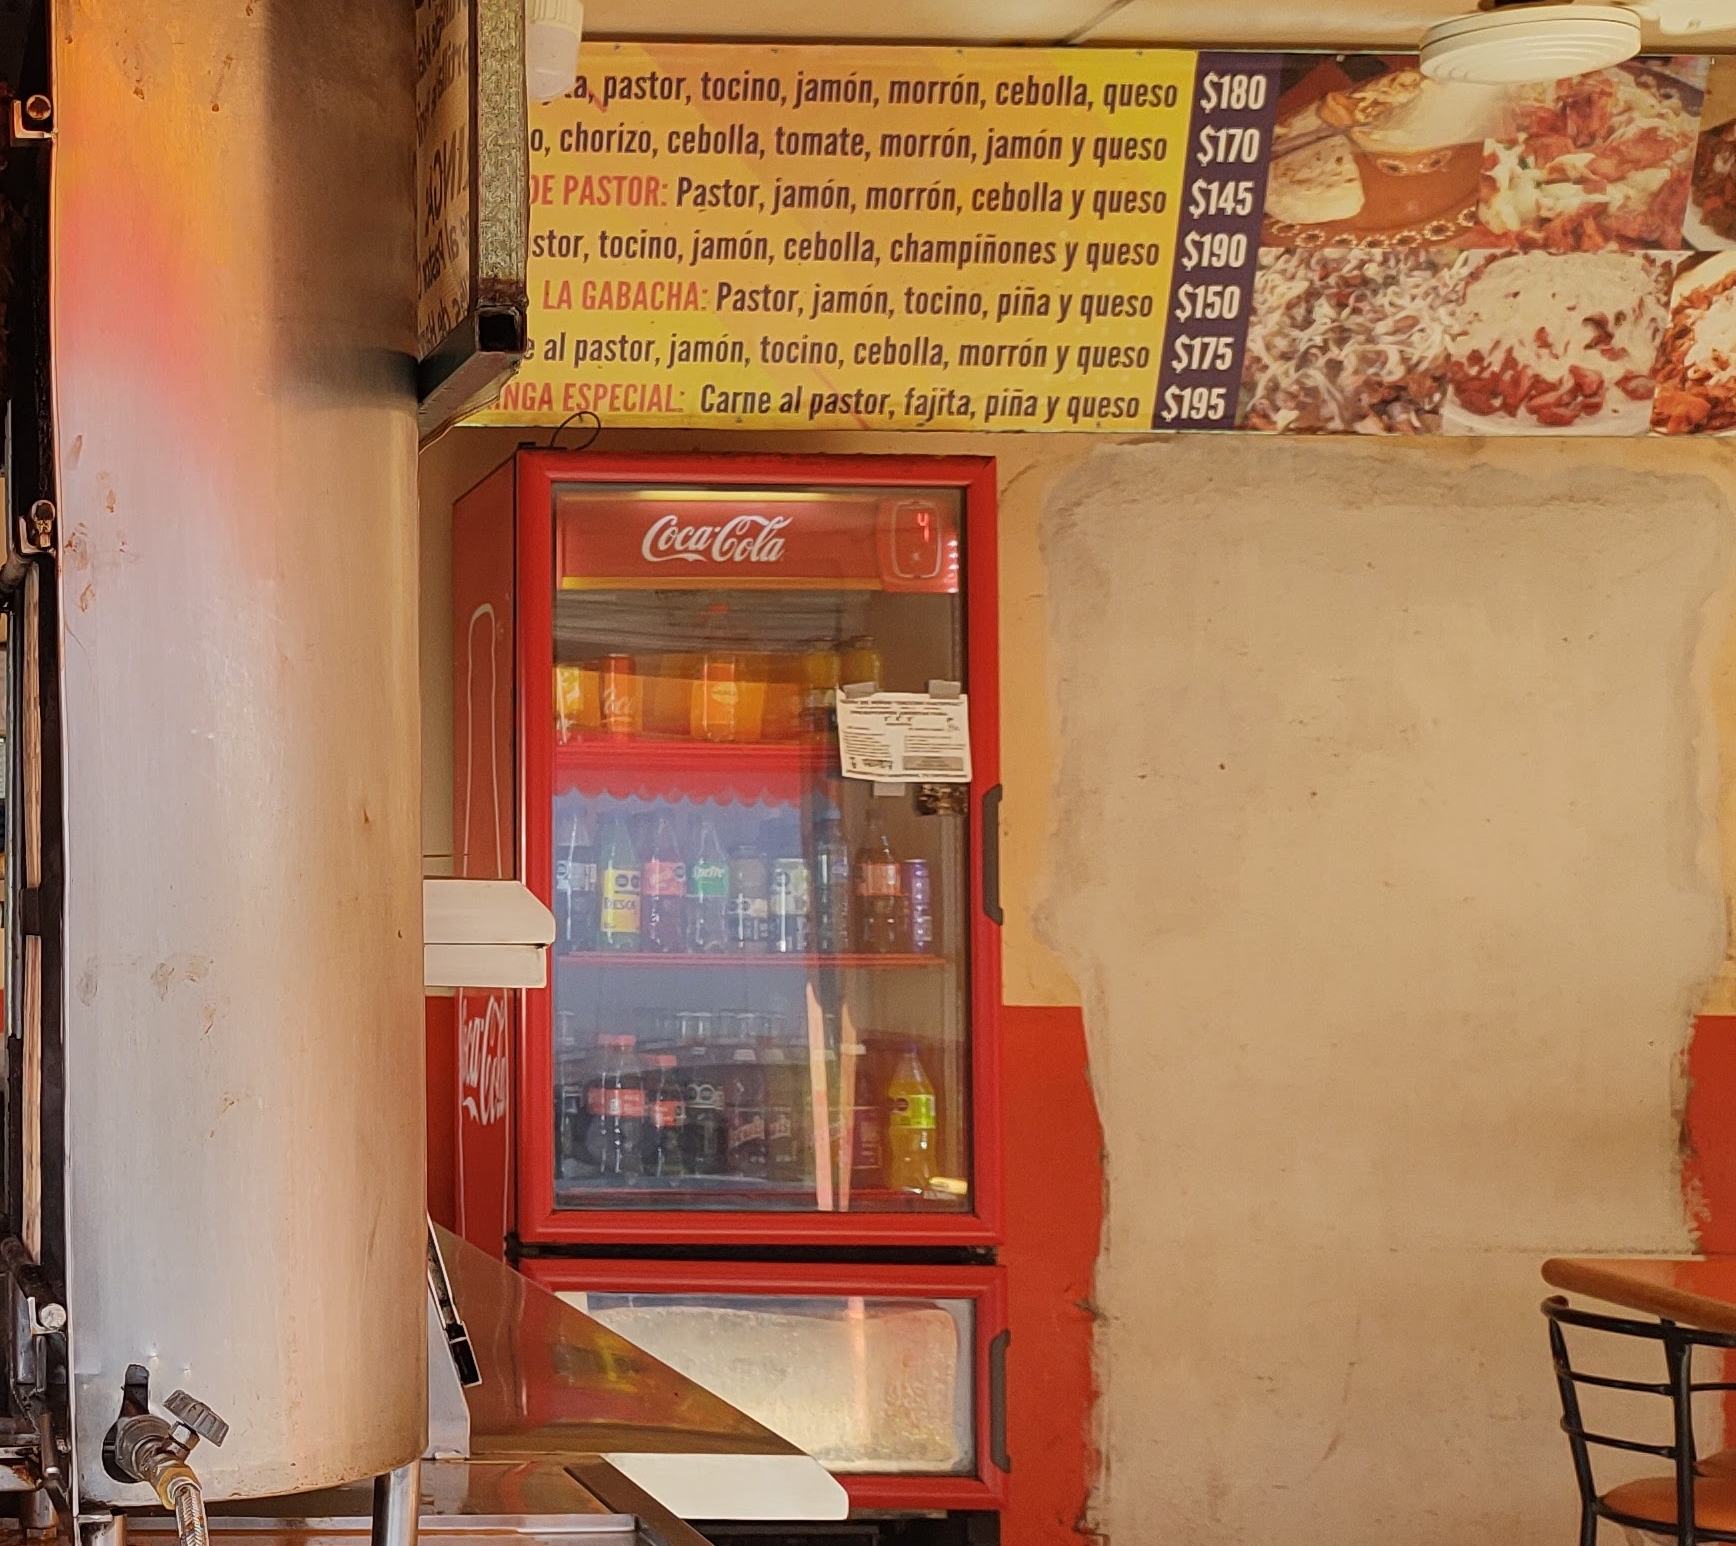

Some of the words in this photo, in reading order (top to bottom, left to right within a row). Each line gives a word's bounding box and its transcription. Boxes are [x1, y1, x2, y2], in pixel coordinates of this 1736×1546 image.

[603, 71, 691, 107] pastor,
[701, 70, 787, 107] tocino,
[793, 70, 880, 109] jamón,
[888, 73, 987, 110] morrón,
[996, 75, 1094, 112] cebolla,
[1103, 83, 1178, 114] queso
[1200, 71, 1267, 113] $180
[560, 121, 659, 159] chorizo,
[667, 124, 765, 160] cebolla,
[775, 126, 871, 161] tomate,
[879, 128, 977, 164] morrón,
[983, 128, 1062, 165] jamón
[1068, 136, 1086, 168] y
[1092, 137, 1167, 168] queso
[1196, 125, 1261, 167] $170
[564, 175, 669, 207] PASTOR:
[676, 176, 765, 213] Pastor,
[770, 177, 856, 215] jamón,
[865, 180, 963, 215] morrón,
[972, 182, 1063, 212] cebolla
[1068, 189, 1085, 220] y
[1092, 190, 1166, 220] queso
[1189, 178, 1255, 220] $145
[531, 230, 589, 263] stor,
[599, 229, 683, 264] tocino,
[689, 230, 775, 267] jamón,
[784, 231, 881, 268] cebolla,
[890, 233, 1057, 271] champiñones
[1061, 241, 1079, 272] y
[1086, 241, 1160, 273] queso
[1181, 230, 1248, 271] $190
[542, 280, 572, 310] LA
[581, 280, 708, 312] GABACHA:
[716, 282, 804, 318] Pastor,
[809, 283, 895, 320] jamón,
[904, 285, 988, 320] tocino,
[996, 286, 1051, 323] piña
[1056, 293, 1073, 324] y
[1080, 294, 1153, 324] queso
[1175, 282, 1241, 323] $150
[544, 332, 567, 362] al
[574, 334, 661, 369] pastor,
[666, 333, 751, 369] jamón,
[760, 334, 844, 369] tocino,
[853, 336, 949, 371] cebolla,
[958, 338, 1047, 368] morrón
[1053, 344, 1070, 375] y
[1077, 344, 1150, 375] queso
[1171, 334, 1235, 374] $175
[492, 382, 554, 412] NGA
[564, 382, 686, 414] ESPECIAL:
[700, 384, 771, 413] Carne
[778, 385, 803, 414] al
[808, 388, 895, 421] pastor,
[904, 387, 976, 423] fajita,
[984, 388, 1038, 423] piña
[1043, 395, 1060, 424] y
[1067, 396, 1140, 424] queso
[1161, 384, 1227, 423] $195
[642, 514, 793, 562] Coca-Cola
